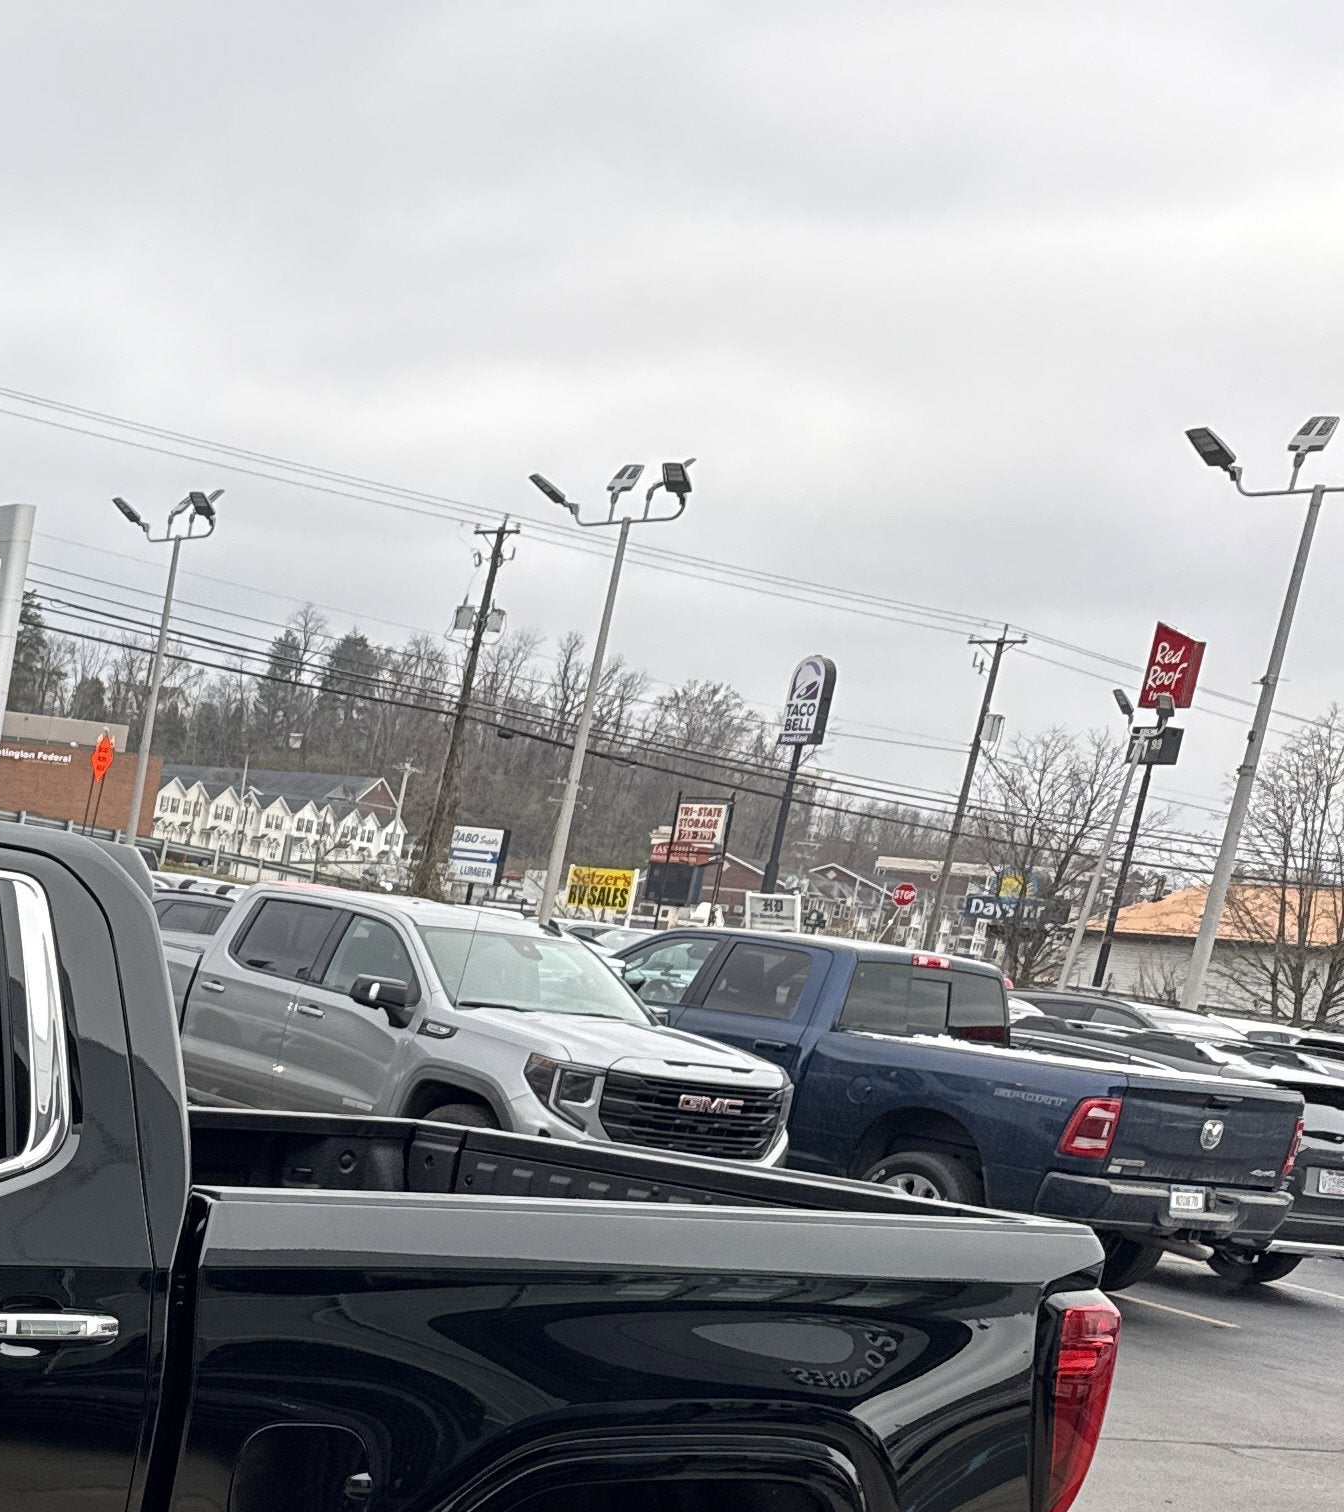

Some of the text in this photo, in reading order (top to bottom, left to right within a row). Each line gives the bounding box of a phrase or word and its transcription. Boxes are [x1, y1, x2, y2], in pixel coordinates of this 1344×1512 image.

[1155, 641, 1186, 665] Red
[1145, 662, 1188, 691] Roof
[786, 702, 816, 718] TACO
[784, 717, 812, 732] BELL
[37, 751, 72, 763] Federal
[680, 806, 723, 818] TRI-STATE
[678, 817, 719, 830] STORAGE
[459, 864, 493, 878] LUMBER
[567, 884, 629, 908] RV SALES
[893, 889, 917, 900] STOP
[678, 1094, 744, 1115] GMC
[993, 1087, 1068, 1107] SPORT
